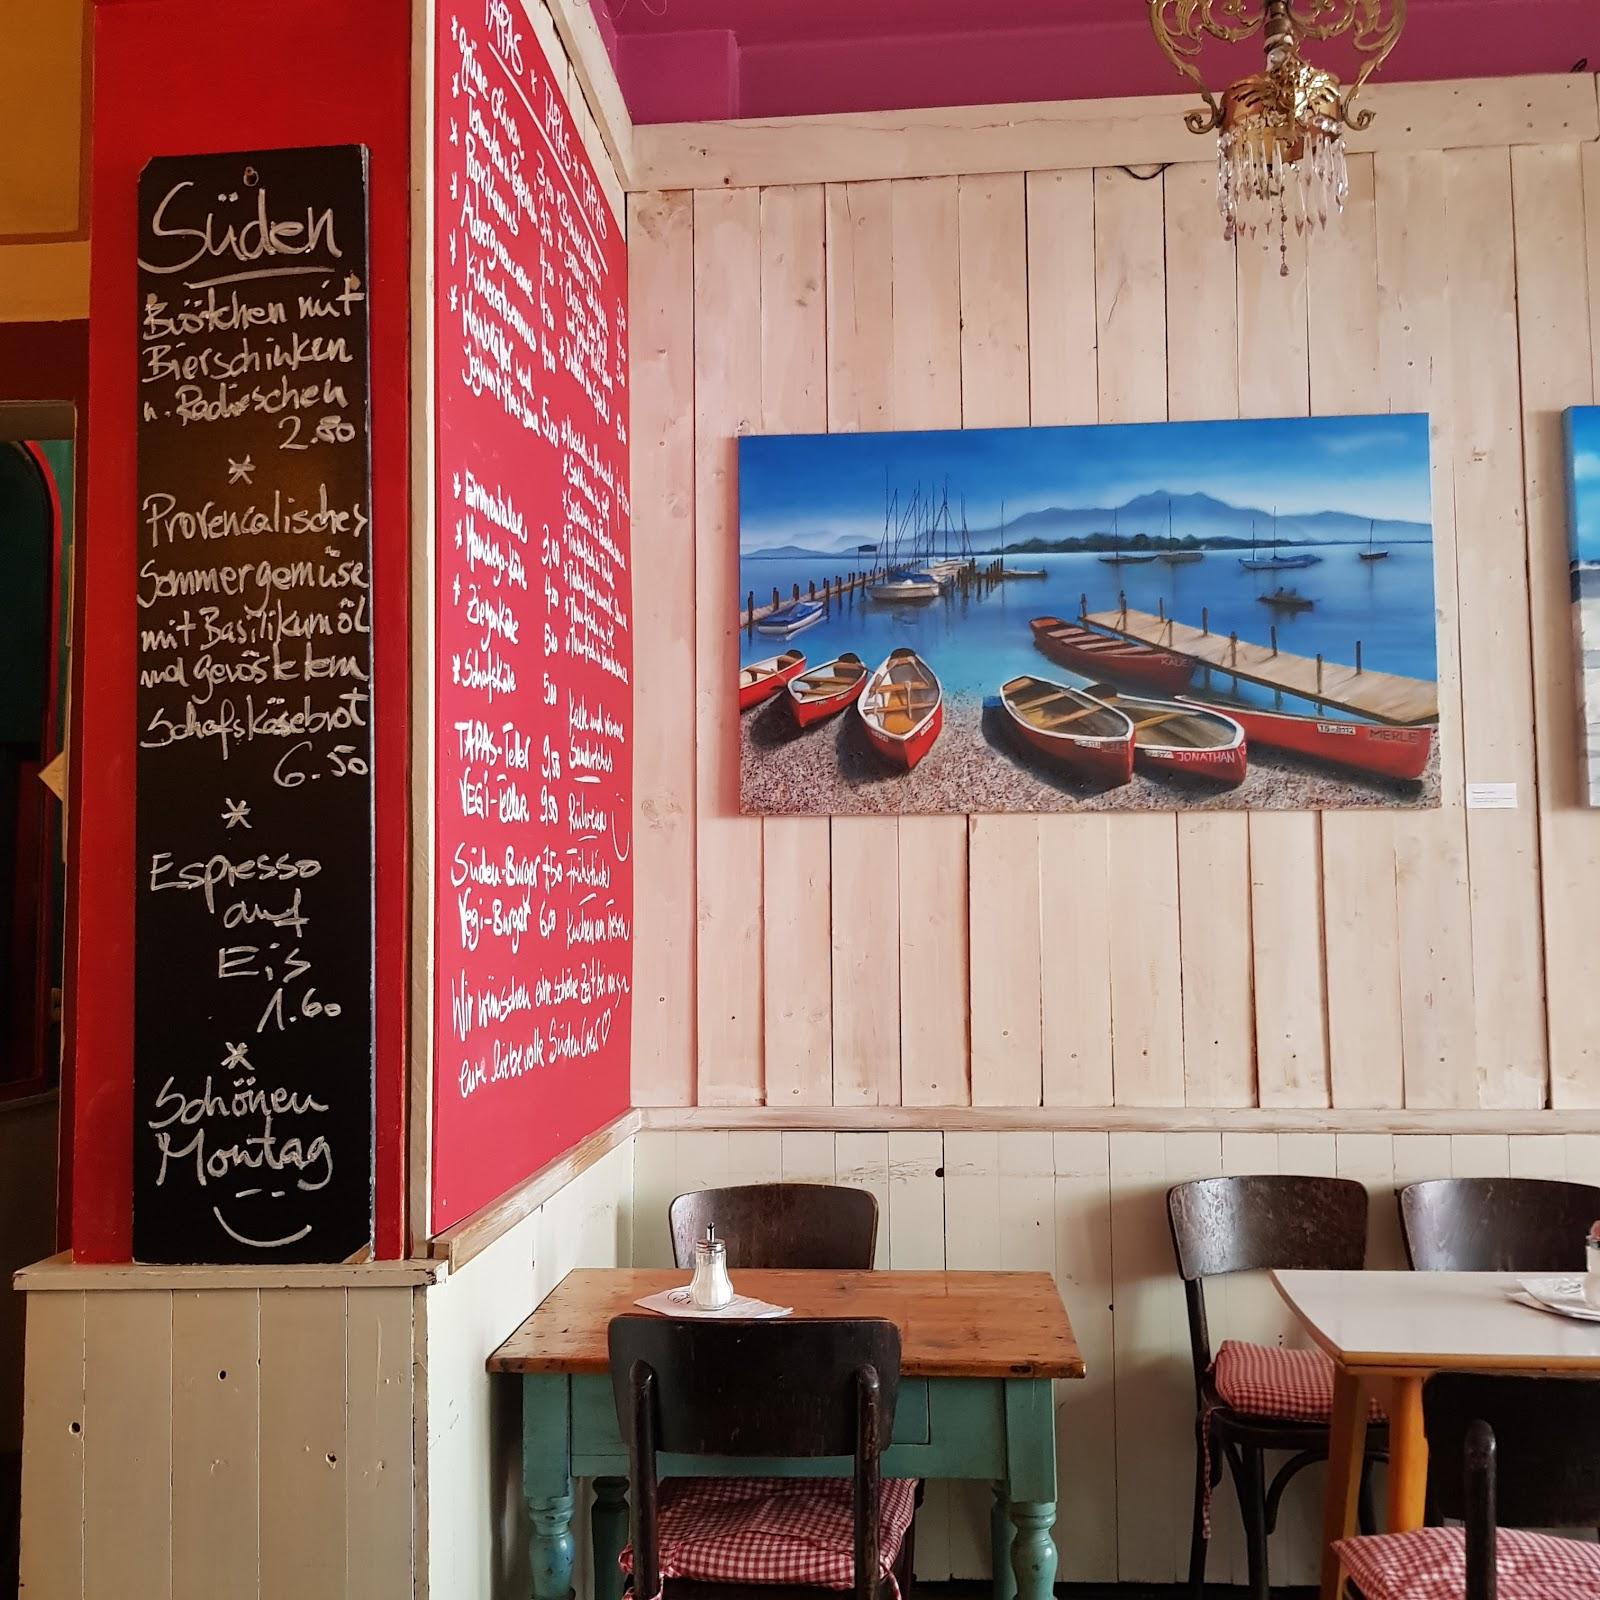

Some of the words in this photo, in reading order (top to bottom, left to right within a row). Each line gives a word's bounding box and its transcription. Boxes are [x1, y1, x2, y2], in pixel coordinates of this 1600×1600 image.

[492, 88, 524, 160] Oliven
[465, 132, 518, 236] Paprikamus
[543, 77, 571, 170] TAPAS
[581, 164, 606, 239] TAPAS
[138, 182, 342, 273] Süden
[143, 287, 287, 340] Brötchen
[299, 276, 364, 319] mit
[142, 333, 352, 382] Bierschinken
[175, 375, 349, 426] Radieschen
[465, 469, 527, 543] Emmentaler
[137, 546, 368, 620] Sommergemüse
[142, 610, 196, 651] mit
[467, 584, 518, 652] Ziegenkäse
[141, 657, 190, 688] und
[463, 648, 516, 703] Schafskäse
[140, 687, 369, 760] Schafskäsebrot
[455, 720, 530, 771] TAPAS-Teller
[542, 735, 560, 782] 9,50
[569, 734, 612, 772] Sandwiches
[1369, 728, 1419, 743] MERLE
[273, 742, 368, 787] 6.50
[1175, 746, 1236, 764] JONATHAN
[150, 852, 322, 913] Espresso
[451, 842, 540, 903] Süden-Burger
[224, 889, 310, 937] auf
[458, 887, 531, 954] Vegi-Burger
[218, 942, 311, 982] Eis
[257, 988, 341, 1032] 1.60
[452, 969, 473, 1041] Wir
[478, 976, 531, 1028] wünschen
[581, 958, 596, 1004] Zeit
[148, 1076, 328, 1128] Schönen
[155, 1117, 333, 1191] Montag
